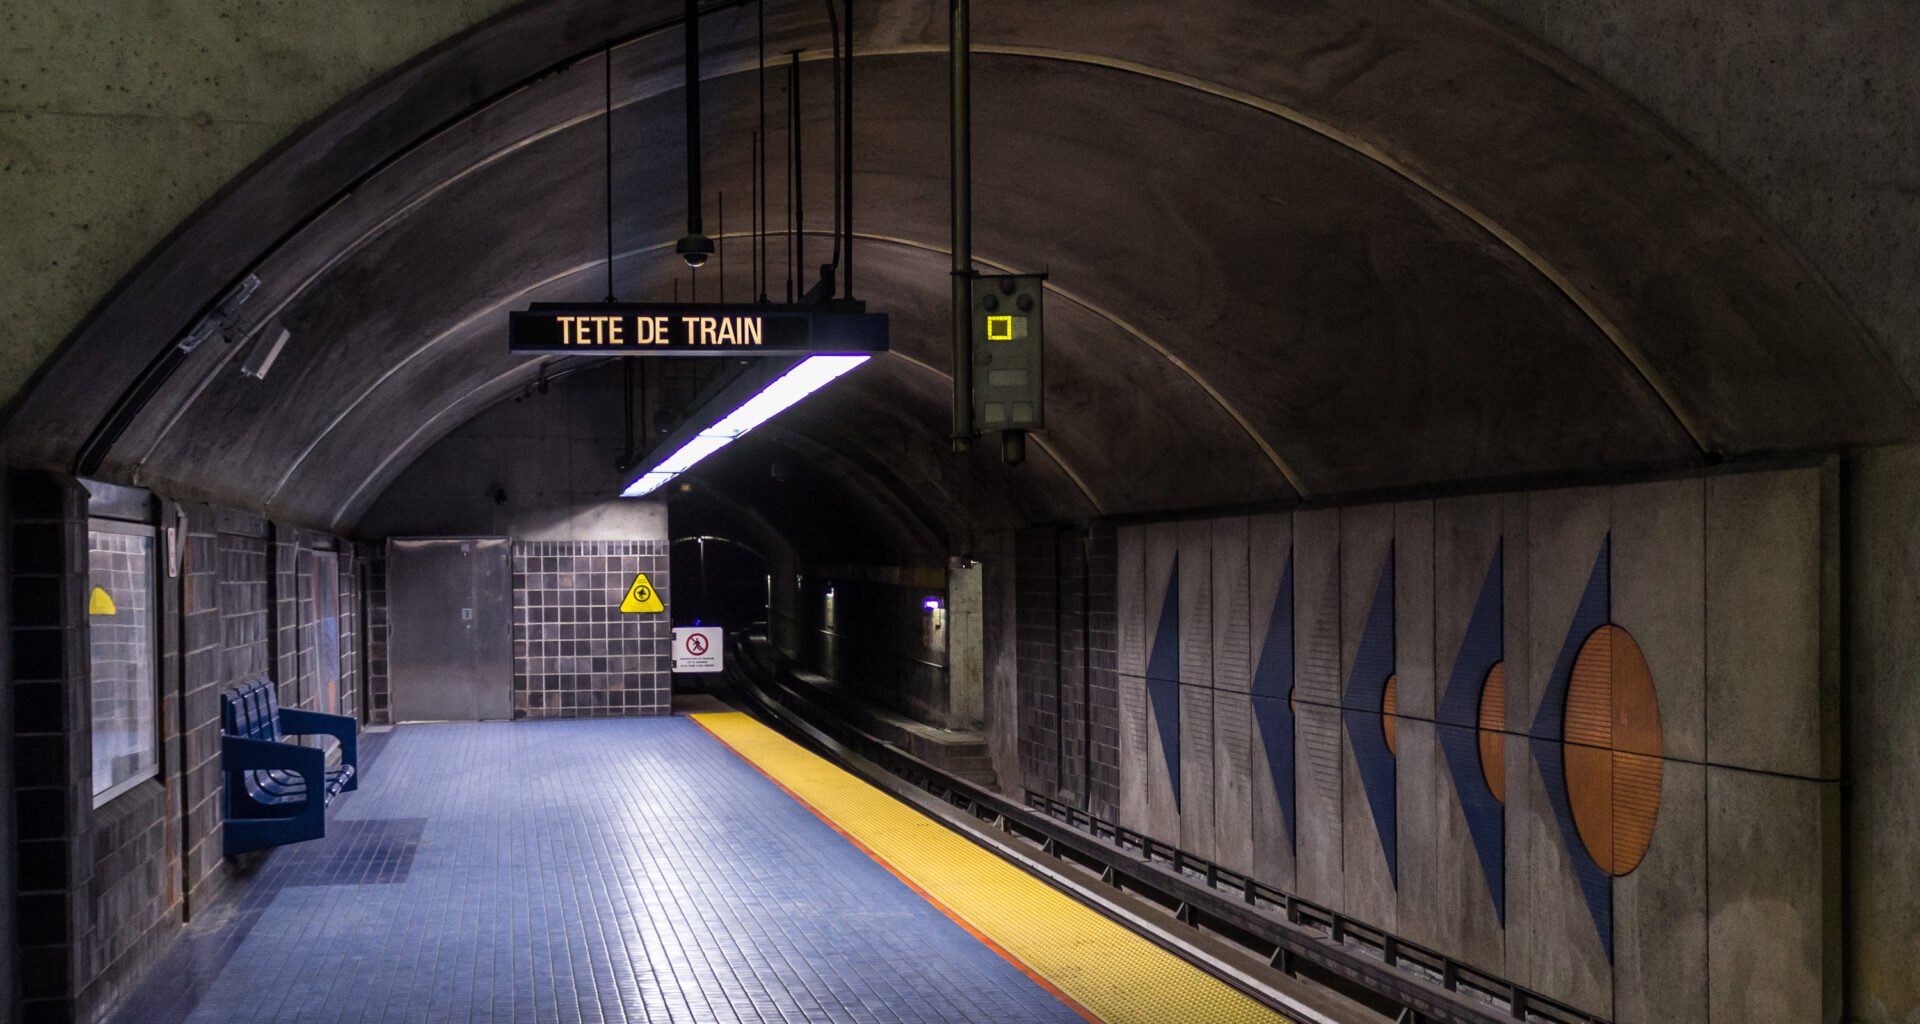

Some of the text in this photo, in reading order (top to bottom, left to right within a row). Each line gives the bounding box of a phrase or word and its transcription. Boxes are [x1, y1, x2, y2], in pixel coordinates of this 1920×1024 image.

[557, 316, 762, 345] TETE DE TRAIN
